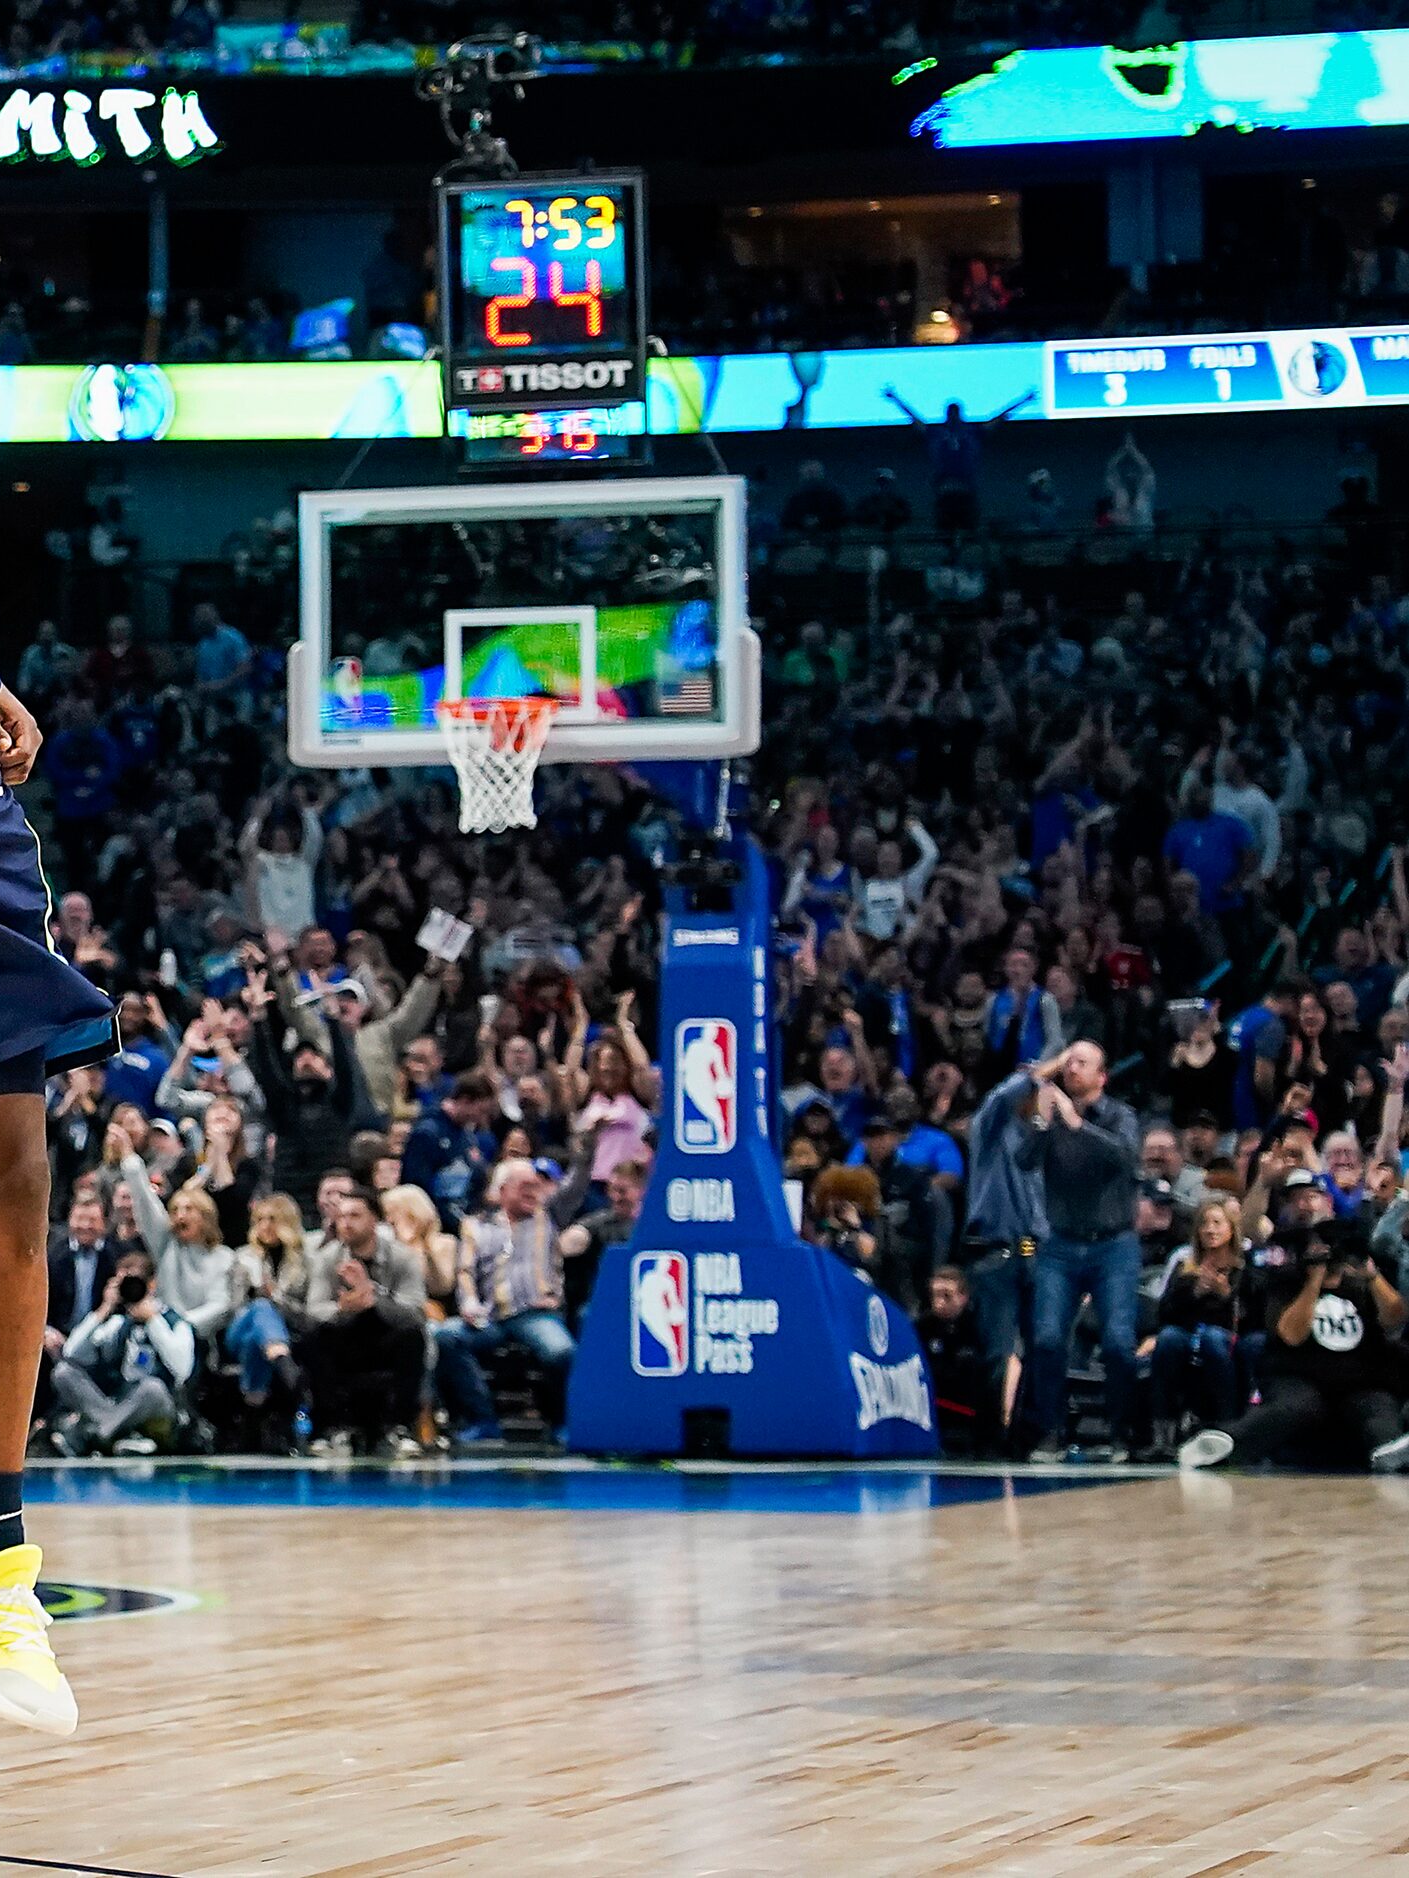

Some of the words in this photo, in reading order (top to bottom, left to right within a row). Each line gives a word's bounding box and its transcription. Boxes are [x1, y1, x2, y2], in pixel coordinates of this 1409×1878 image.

[505, 196, 616, 251] 7:53
[486, 256, 602, 347] 24
[503, 359, 634, 392] TISSOT
[1104, 373, 1128, 406] 3
[1214, 368, 1232, 401] 1
[666, 1177, 736, 1222] @NBA
[694, 1253, 742, 1295] NBA
[695, 1296, 780, 1341] League
[1314, 1313, 1359, 1337] TNT
[695, 1335, 754, 1374] Pass
